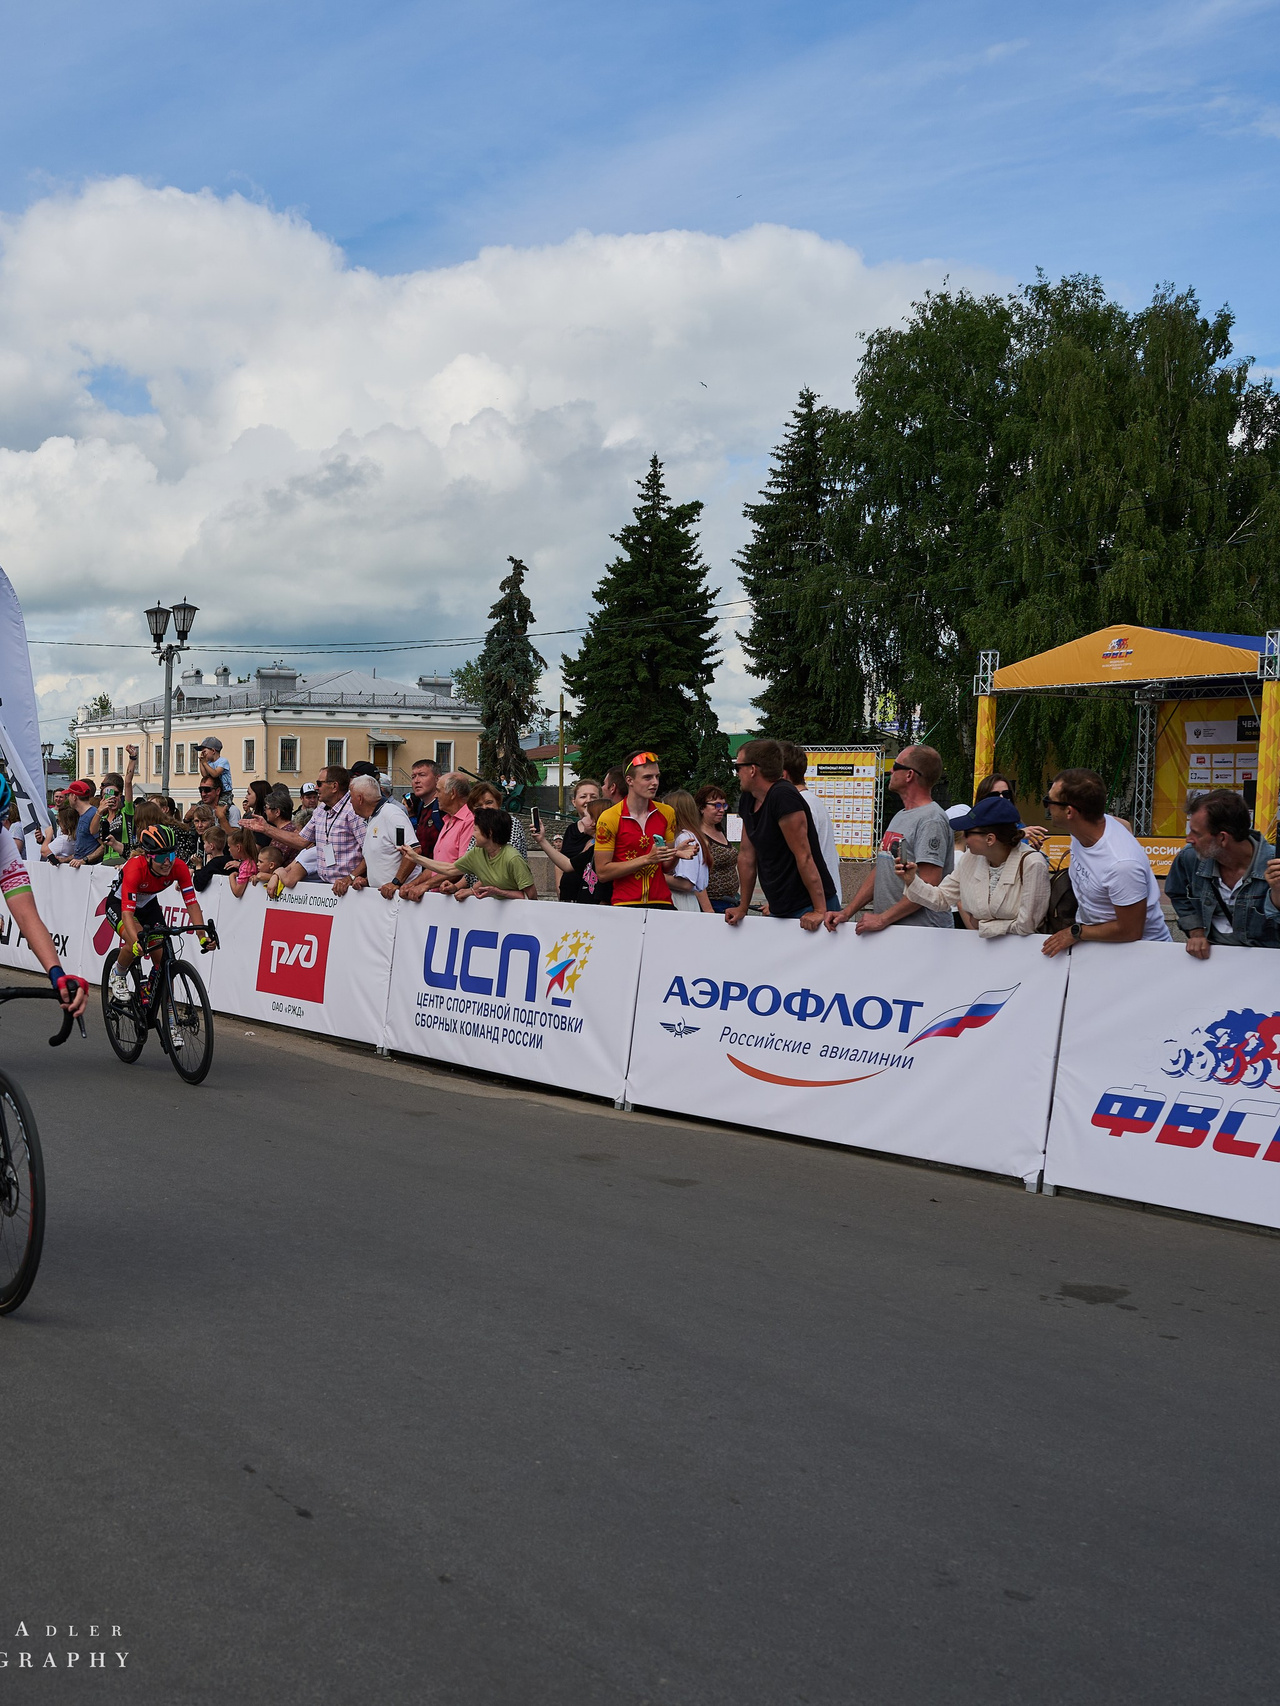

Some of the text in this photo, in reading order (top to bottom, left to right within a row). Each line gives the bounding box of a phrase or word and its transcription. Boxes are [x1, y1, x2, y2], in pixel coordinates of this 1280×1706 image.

[1102, 649, 1133, 659] ФВСР
[308, 896, 338, 908] СПОНСОР
[423, 925, 541, 1003] ЦСП
[271, 1001, 305, 1018] ОАО «РЖД»
[416, 992, 584, 1034] ЦЕНТР СПОРТИВНОЙ ПОДГОТОВКИ
[662, 975, 924, 1034] АЭРОФЛОТ
[414, 1013, 544, 1050] СБОРНЫХ КОМАНД РОССИИ
[719, 1026, 915, 1070] Российские авиалинии
